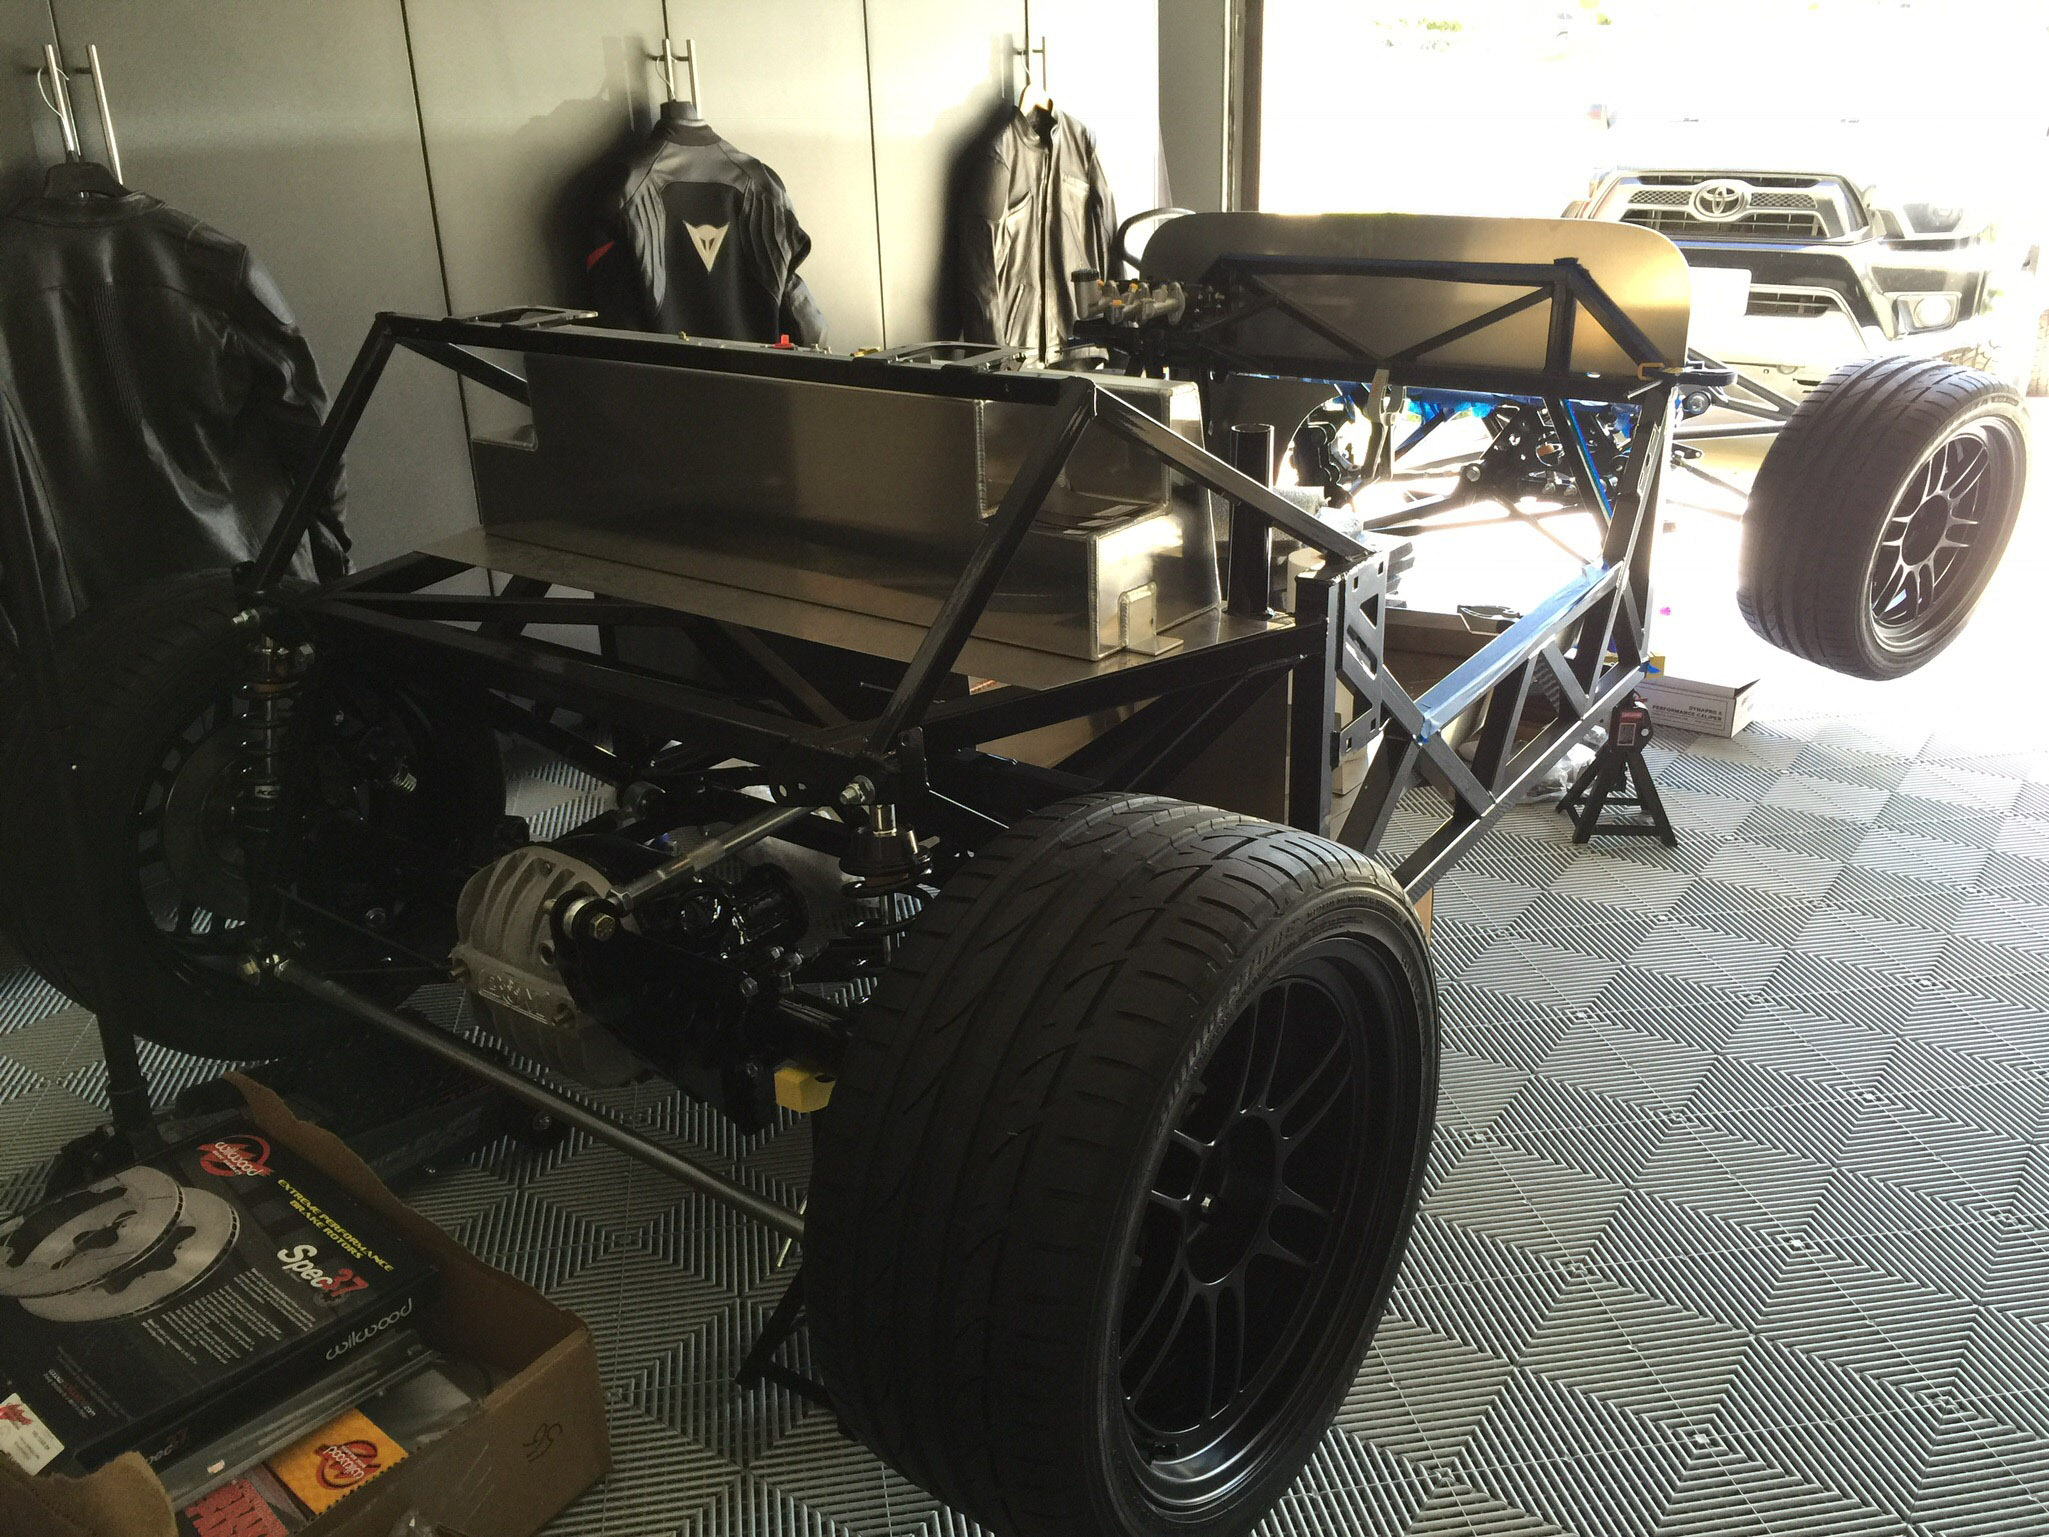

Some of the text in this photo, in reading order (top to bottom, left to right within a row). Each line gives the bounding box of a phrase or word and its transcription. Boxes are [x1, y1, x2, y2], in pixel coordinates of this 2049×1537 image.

[1652, 704, 1696, 717] PERFORMANCE
[1696, 713, 1722, 721] CALIPER
[214, 1141, 265, 1177] wilwood
[277, 1178, 395, 1274] EXTREME PERFORMANCE
[289, 1199, 364, 1260] BRAKE ROTORS
[277, 1244, 370, 1297] Spec37
[325, 1297, 413, 1361] wilwood
[322, 1445, 366, 1479] wilwood
